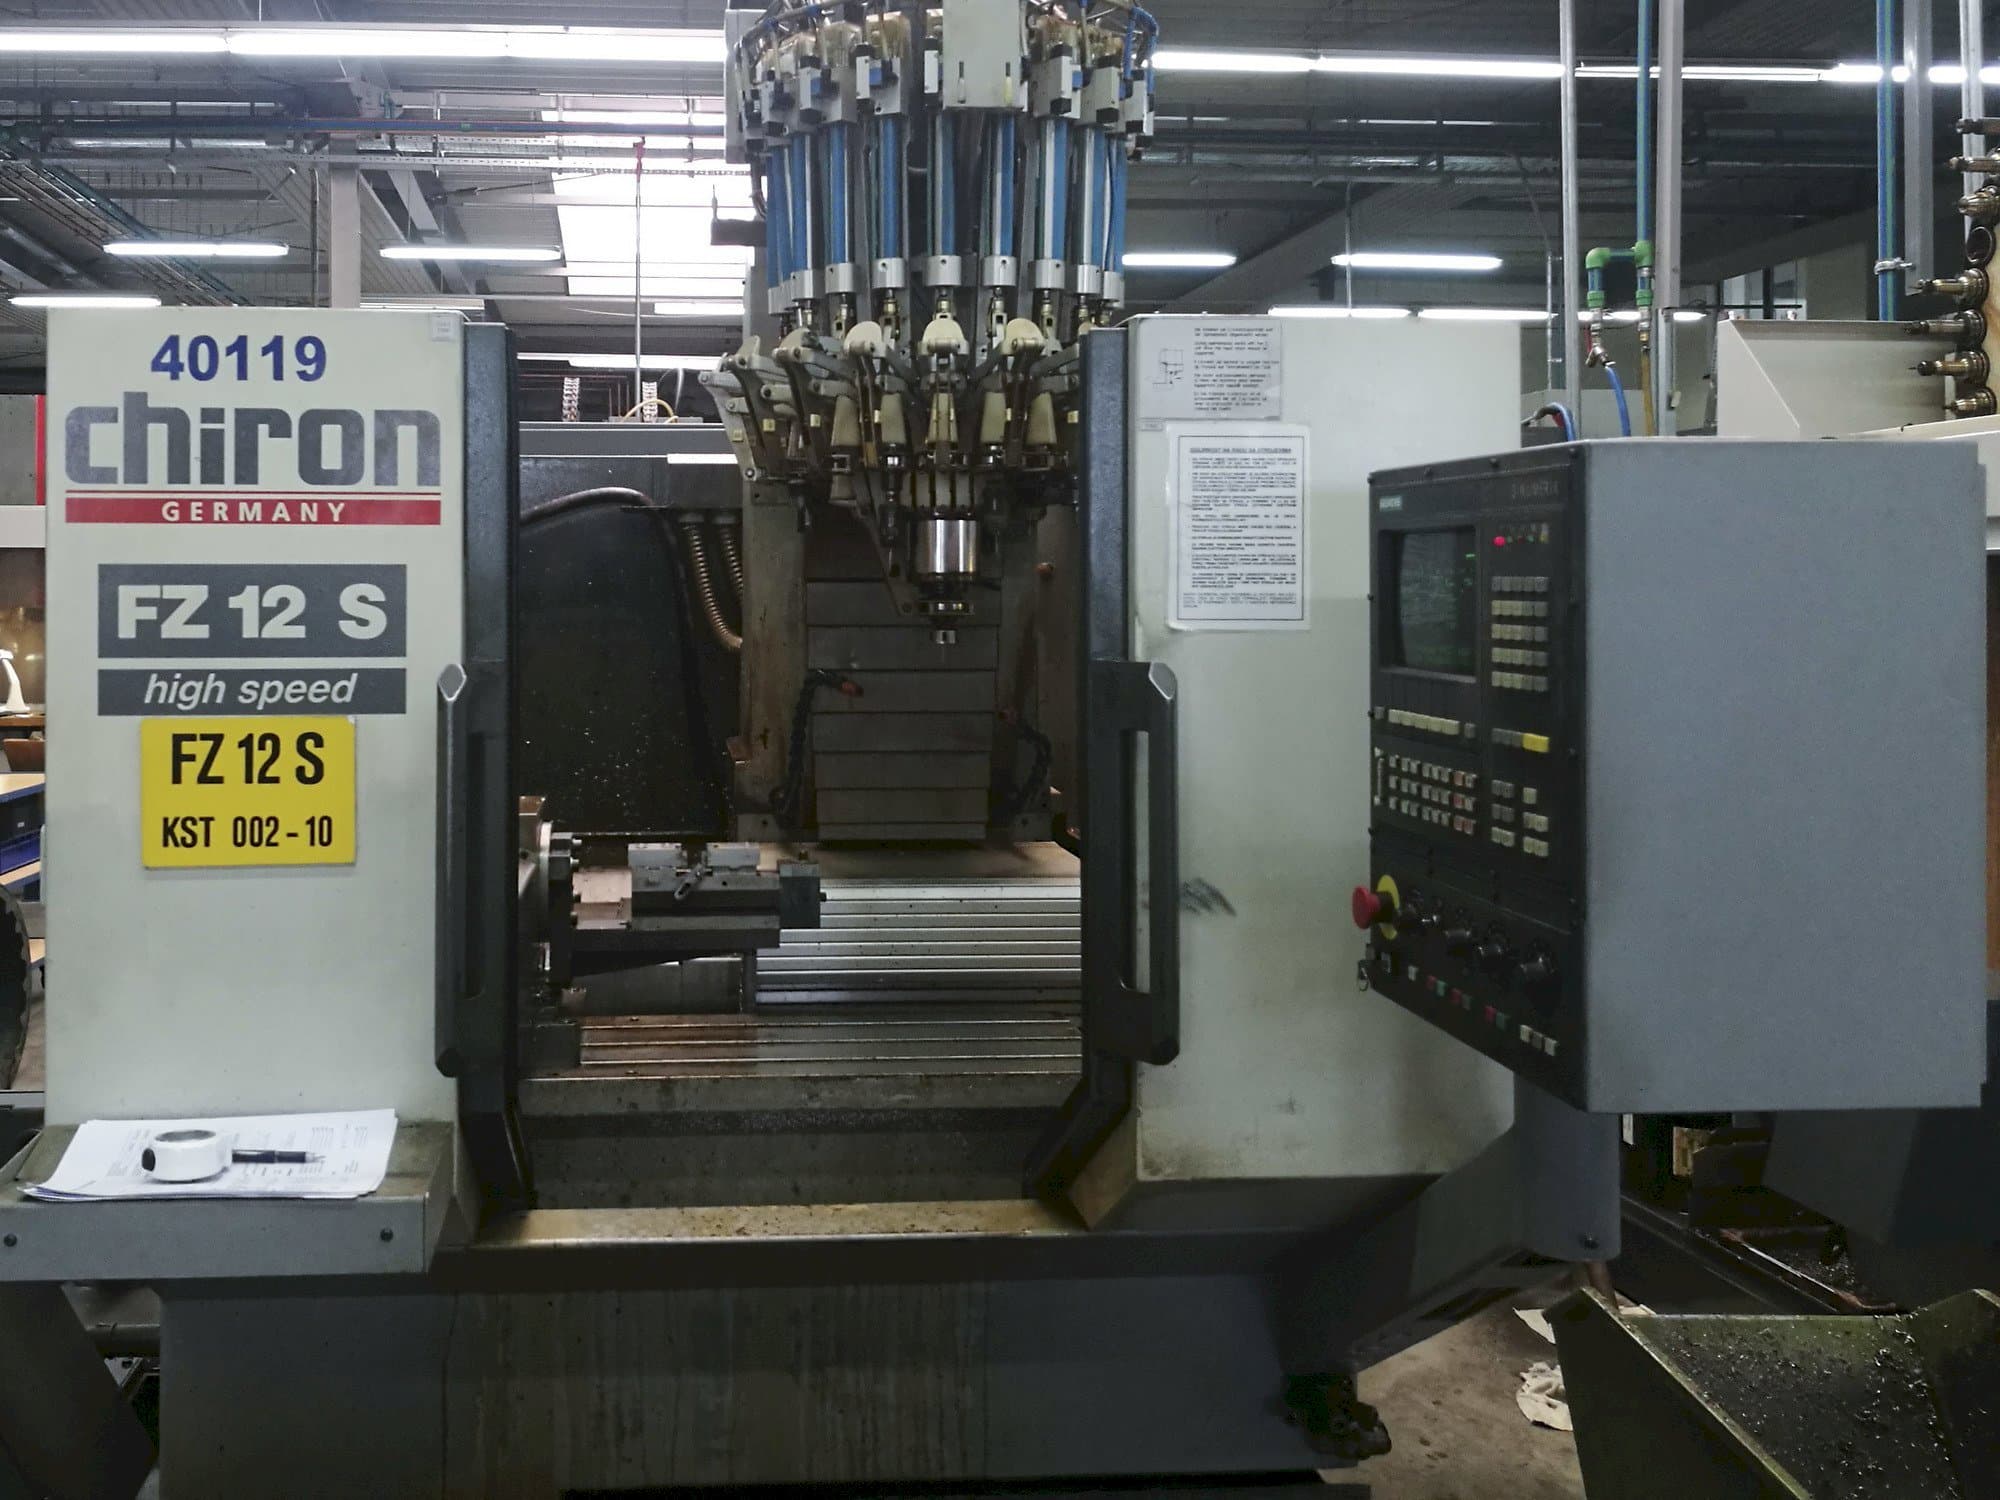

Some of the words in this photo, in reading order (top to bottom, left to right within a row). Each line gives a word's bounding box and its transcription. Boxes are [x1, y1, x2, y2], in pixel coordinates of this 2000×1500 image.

[151, 334, 327, 382] 40119
[65, 391, 441, 487] chiron
[161, 501, 346, 522] GERMANY
[118, 584, 210, 640] FZ
[228, 584, 306, 640] 12
[338, 583, 387, 641] S
[144, 673, 226, 710] high
[237, 672, 358, 710] speed
[171, 732, 225, 785] FZ
[237, 732, 281, 785] 12
[295, 731, 325, 785] S
[162, 815, 216, 849] KST
